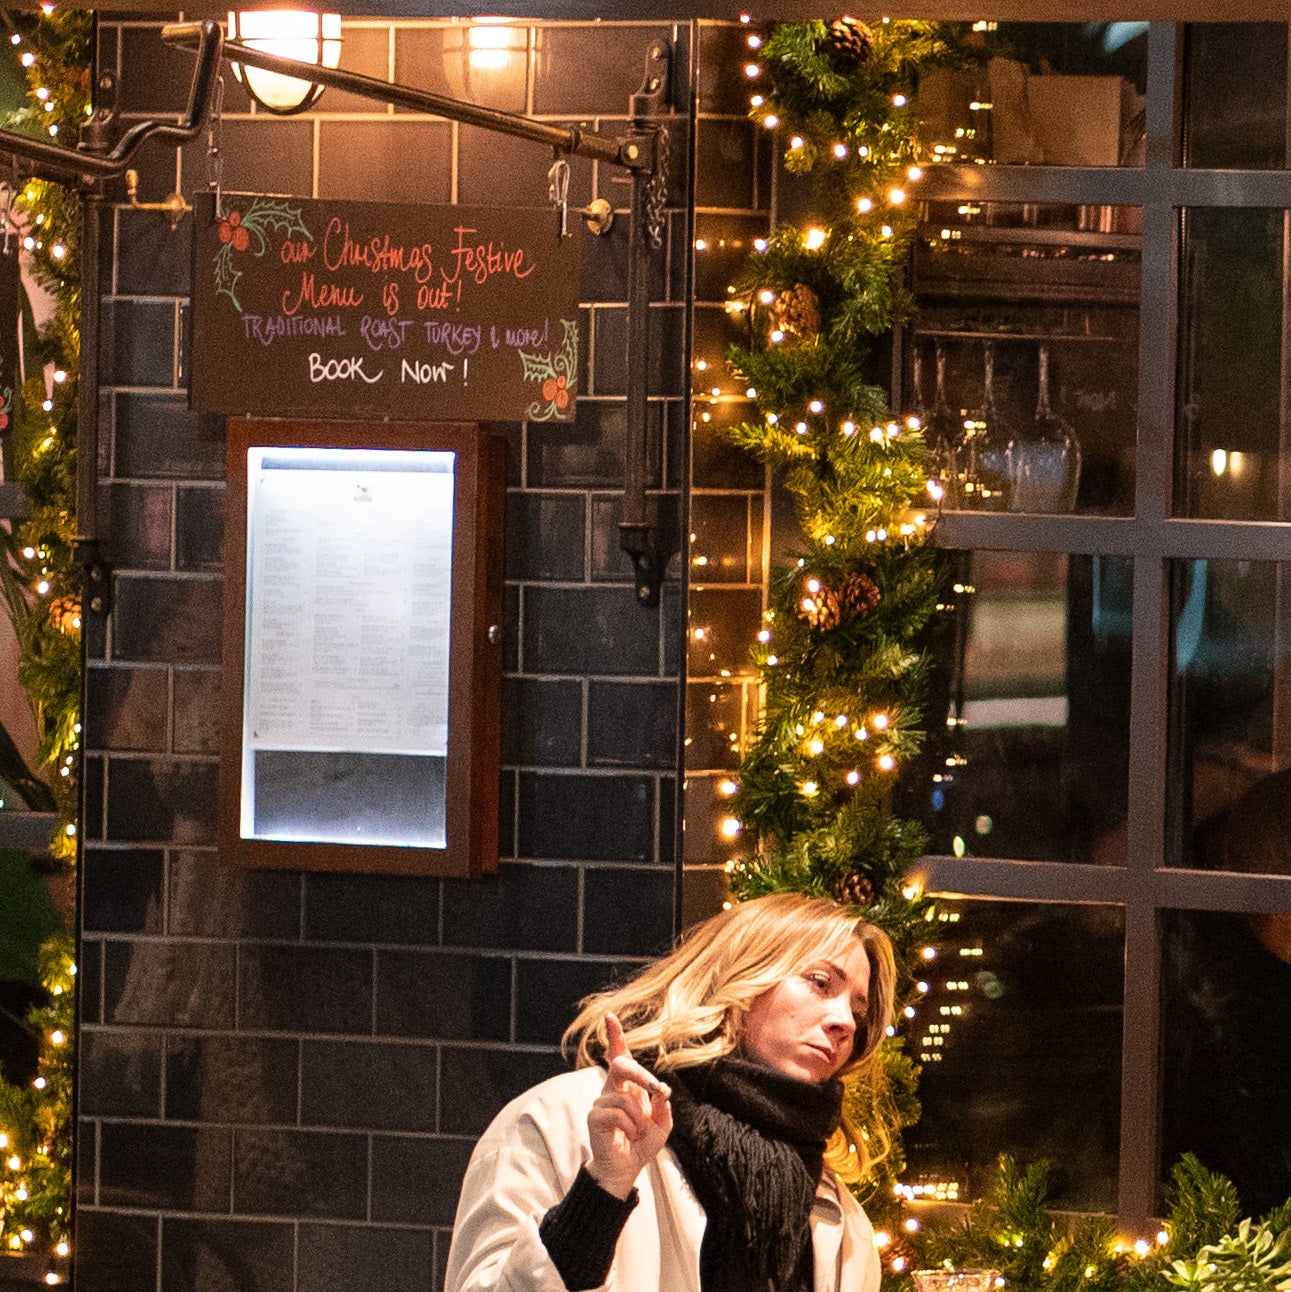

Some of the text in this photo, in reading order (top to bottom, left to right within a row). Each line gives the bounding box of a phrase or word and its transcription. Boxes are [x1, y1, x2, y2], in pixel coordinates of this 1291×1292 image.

[324, 217, 432, 284] Christmas
[440, 225, 536, 284] Festive
[282, 271, 364, 315] Menu
[383, 275, 399, 316] is
[241, 314, 347, 346] TRADITIONAL
[360, 315, 414, 350] ROAST
[424, 321, 481, 355] TURKEY
[308, 353, 384, 383] BOOK
